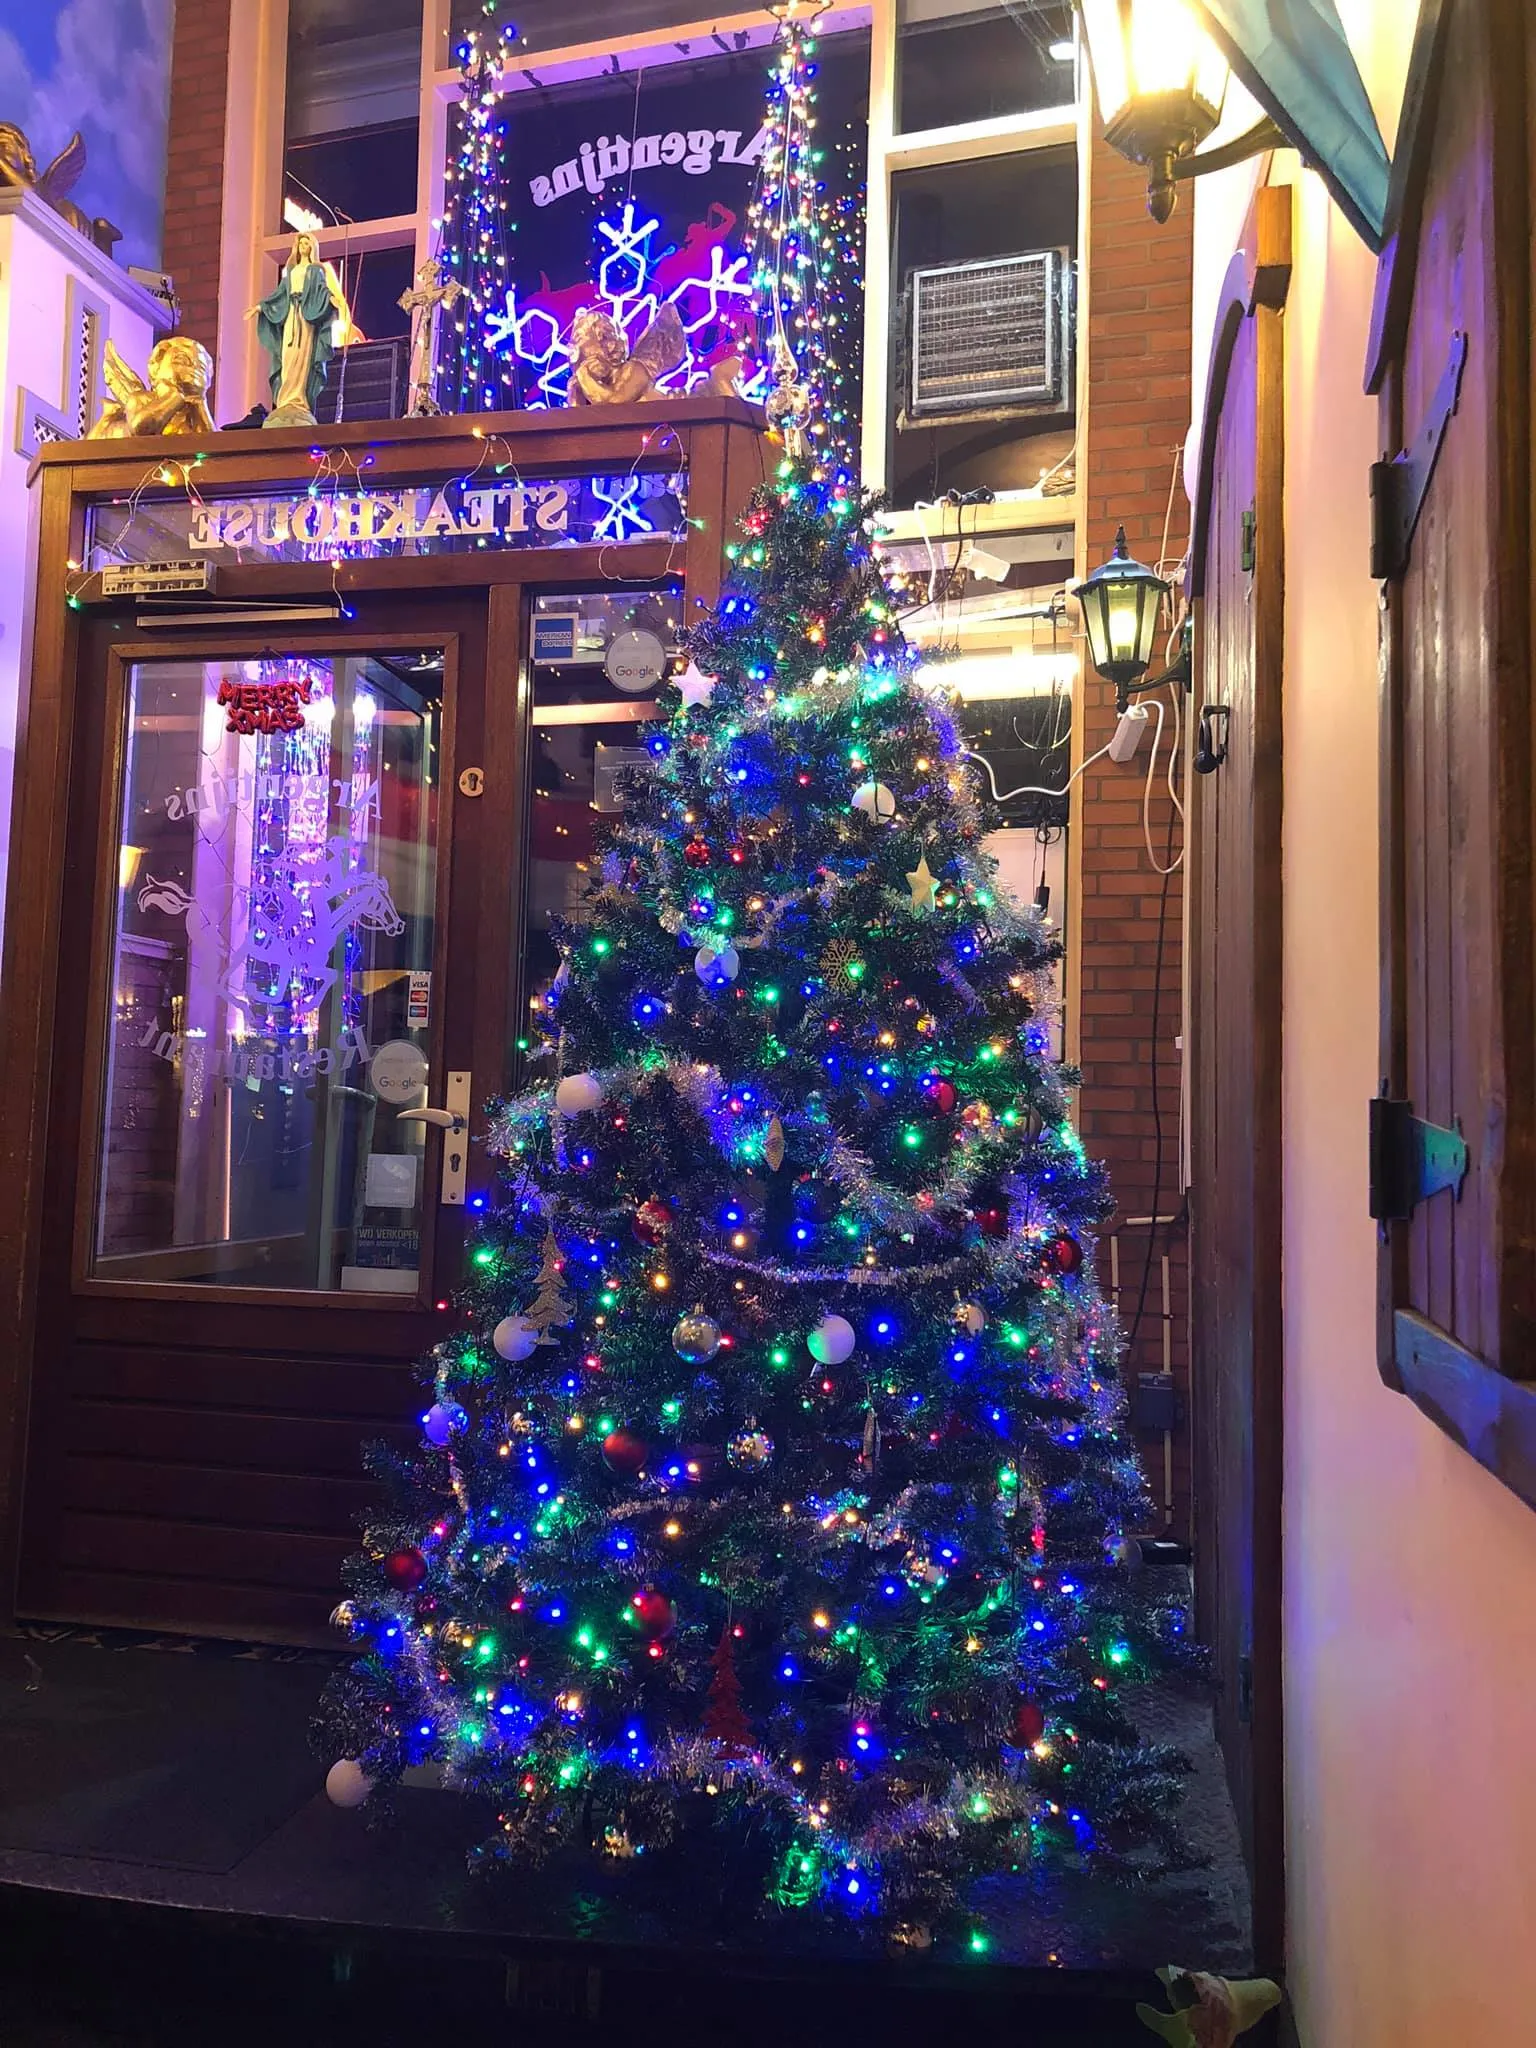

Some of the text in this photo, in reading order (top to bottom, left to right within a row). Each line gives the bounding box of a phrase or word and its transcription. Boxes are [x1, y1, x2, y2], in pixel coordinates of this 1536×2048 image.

[535, 632, 572, 640] AMERICAN
[542, 640, 573, 648] EXPRESS
[615, 665, 655, 679] Google
[217, 675, 313, 711] MERRY
[226, 705, 305, 735] XMAS
[379, 1076, 417, 1090] Google
